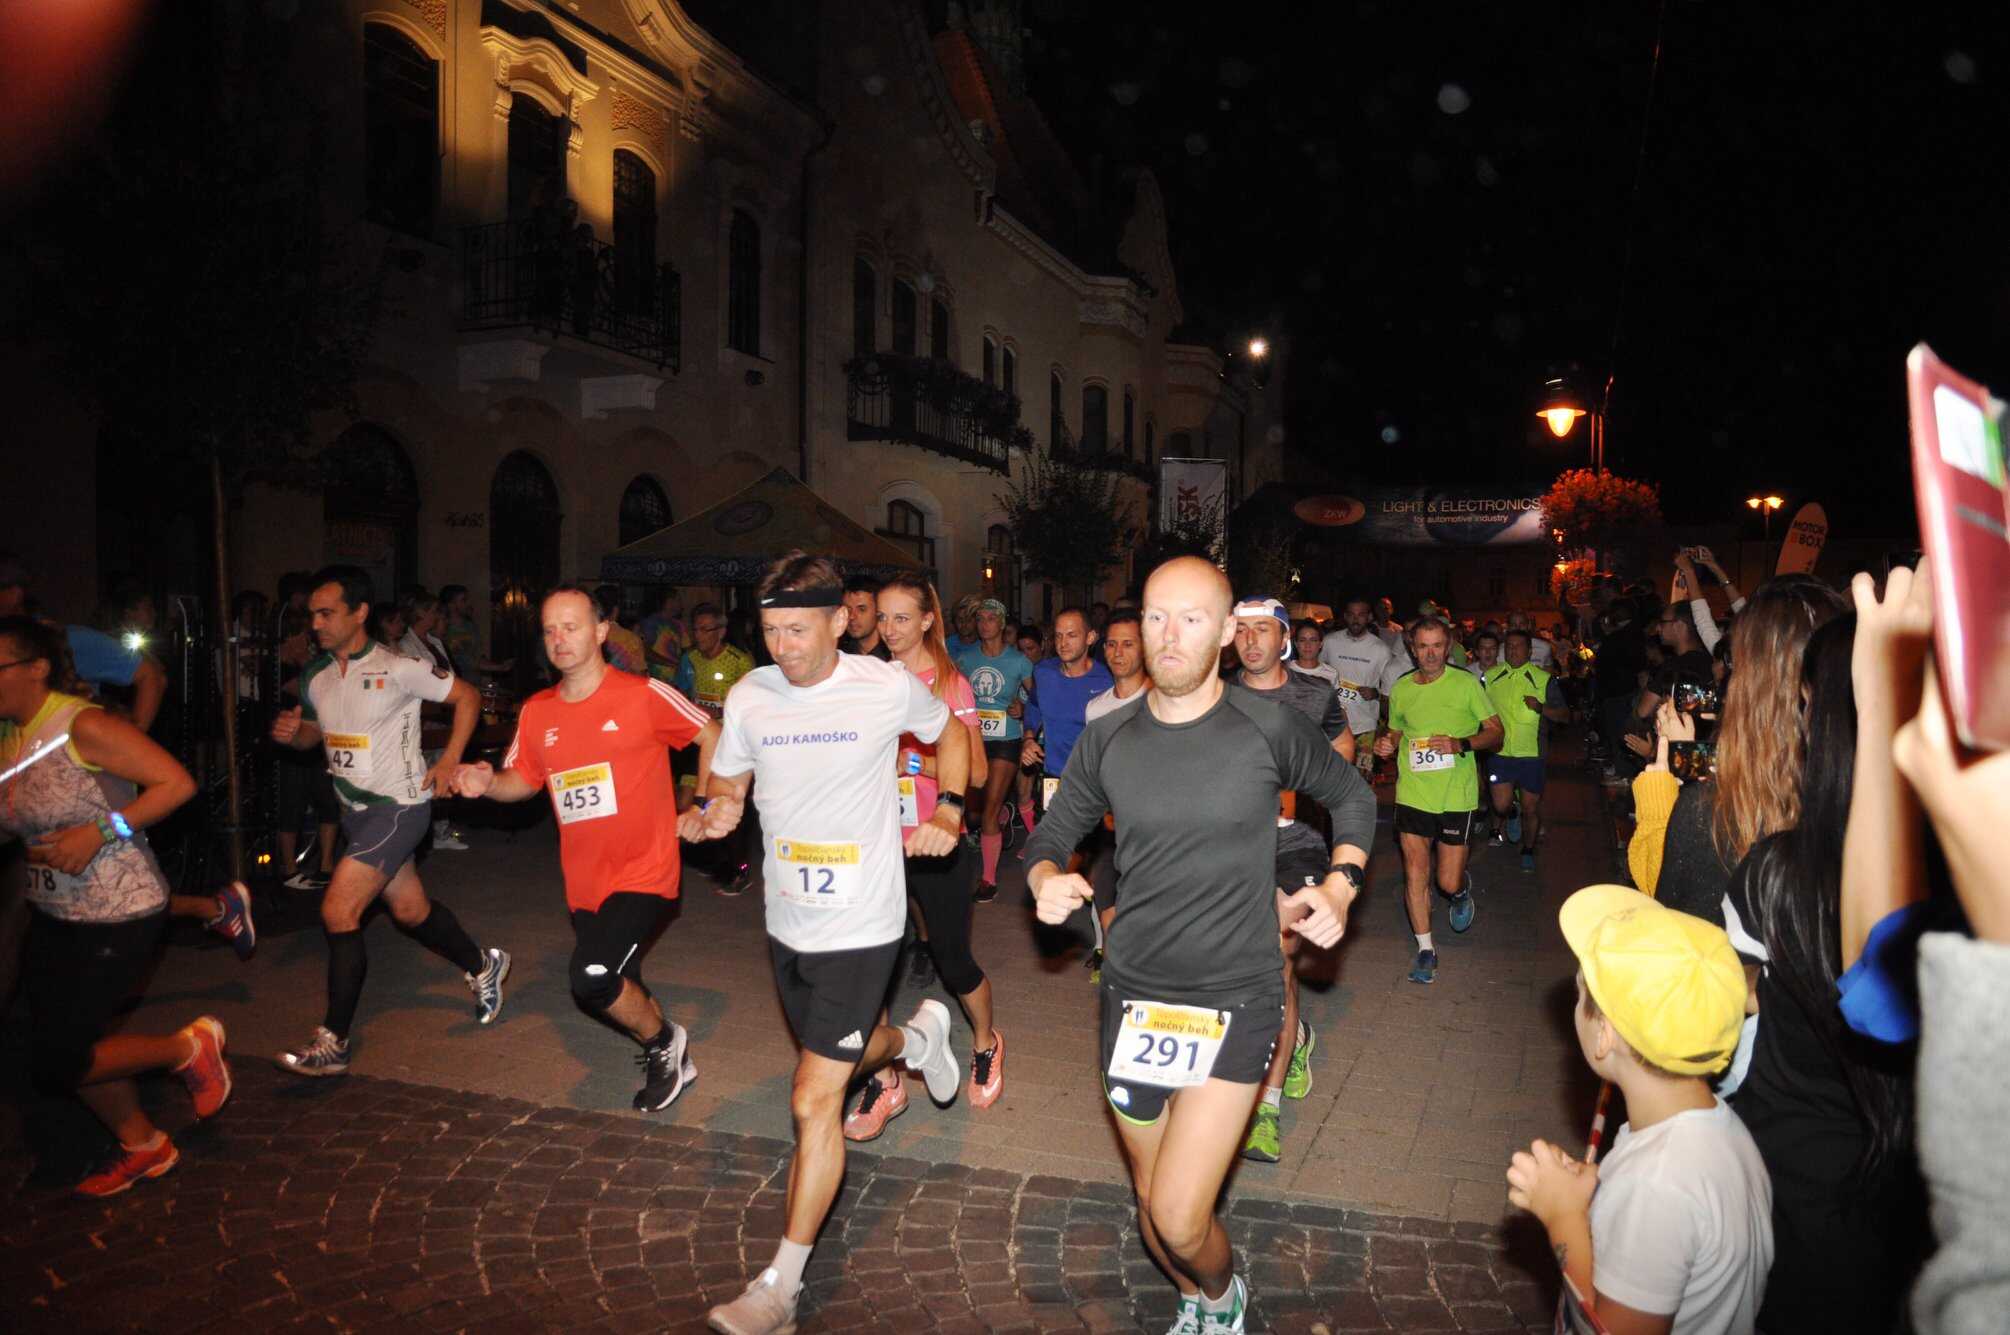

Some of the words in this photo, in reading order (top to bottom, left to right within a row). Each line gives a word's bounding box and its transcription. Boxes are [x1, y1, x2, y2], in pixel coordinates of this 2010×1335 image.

[1382, 500, 1424, 513] LIGHT
[1427, 501, 1437, 513] &
[1441, 497, 1541, 512] ELECTRONICS
[1413, 515, 1424, 524] for
[1427, 515, 1473, 524] automotive
[1475, 514, 1509, 525] industry
[1337, 687, 1358, 701] 232
[332, 750, 355, 769] 42
[563, 785, 601, 811] 453
[798, 867, 836, 894] 12
[1153, 1020, 1185, 1033] nočný
[1187, 1023, 1209, 1036] beh
[1132, 1032, 1199, 1072] 291
